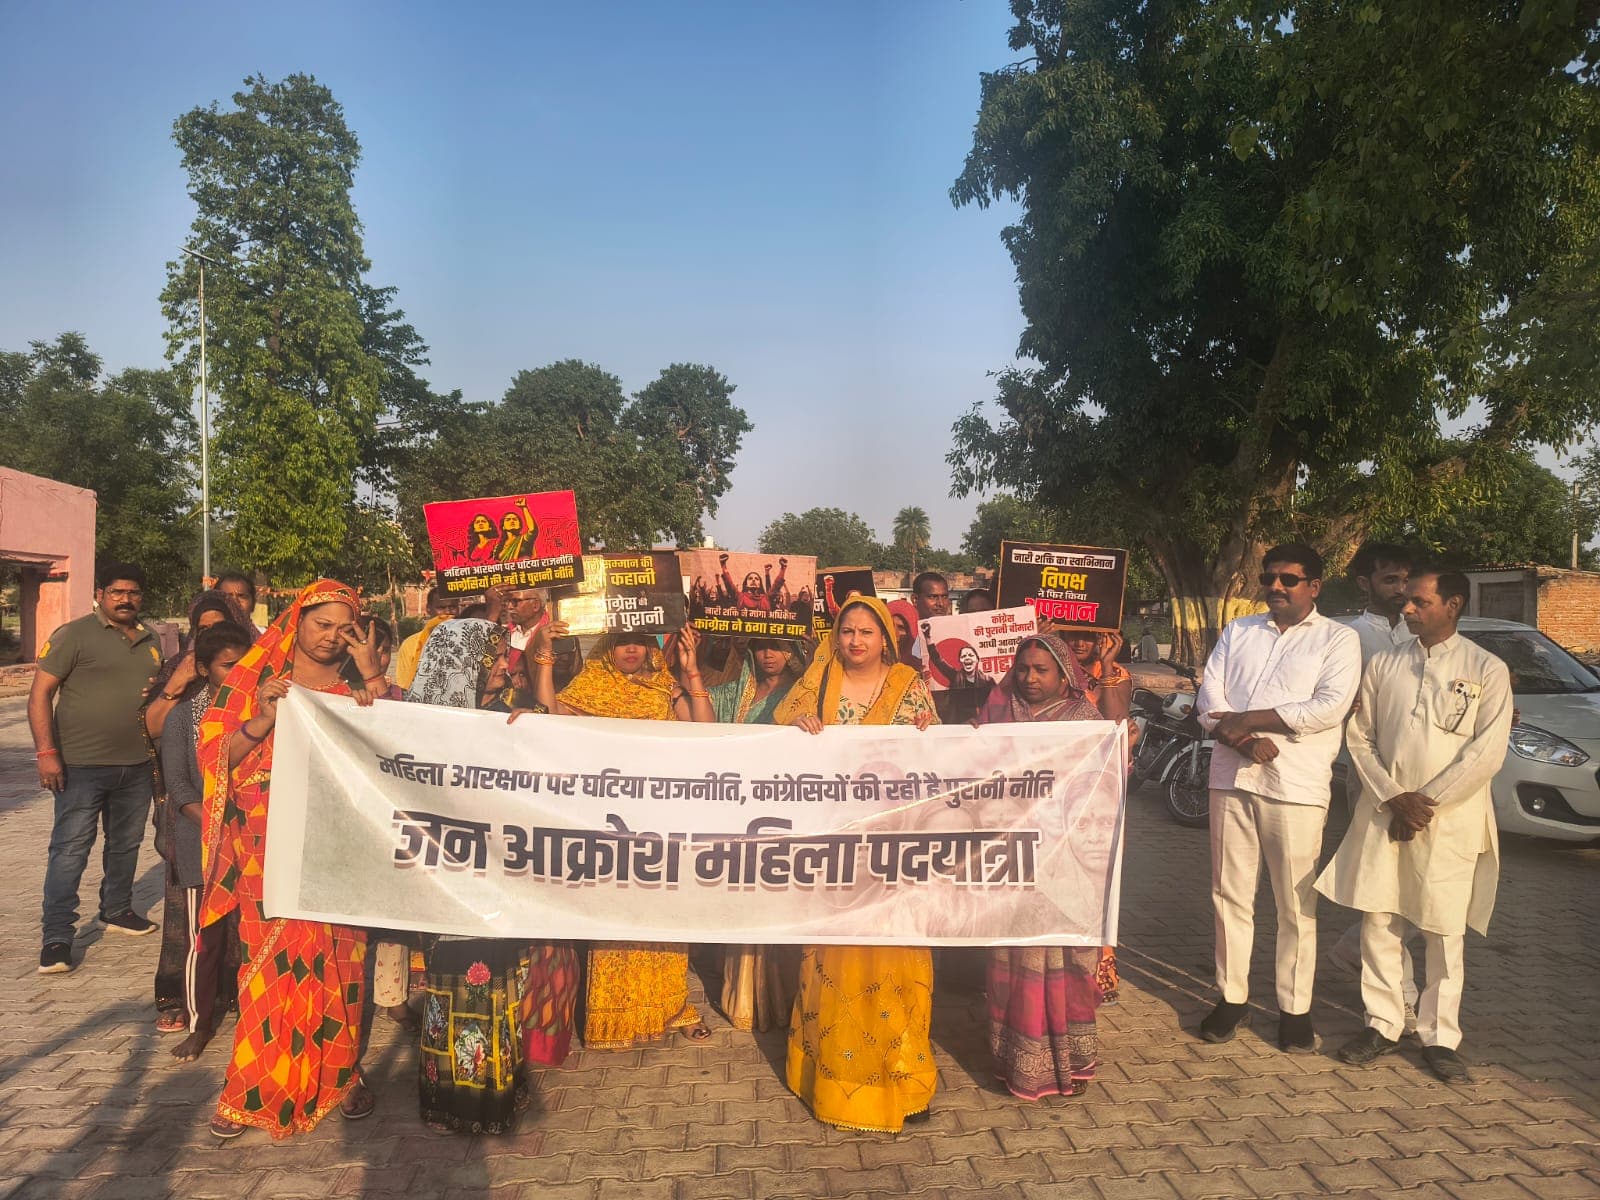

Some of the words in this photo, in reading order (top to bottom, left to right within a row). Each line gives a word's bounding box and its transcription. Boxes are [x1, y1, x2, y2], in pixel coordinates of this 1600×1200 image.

[444, 566, 471, 577] महिला
[473, 563, 503, 574] आरक्षण
[504, 562, 516, 571] पर
[517, 559, 540, 570] घटिया
[541, 554, 574, 567] राजनीति
[640, 555, 654, 569] की
[1014, 552, 1033, 562] नारी
[1035, 553, 1055, 564] शक्ति
[1056, 555, 1068, 565] का
[1069, 556, 1114, 569] स्वाभिमान
[447, 574, 489, 592] कांग्रेसियों
[503, 571, 519, 585] रही
[519, 570, 527, 584] है
[527, 568, 553, 587] पुरानी
[554, 565, 574, 579] नीति
[610, 568, 657, 586] कहानी
[1041, 566, 1088, 591] विपक्ष
[1038, 588, 1045, 598] ने
[1046, 589, 1064, 600] फिर
[1064, 590, 1088, 601] किया
[620, 606, 665, 632] पुरानी
[704, 606, 721, 616] नारी
[722, 607, 739, 617] शक्ति
[991, 613, 1015, 624] कांग्रेस
[694, 616, 730, 632] कांग्रेस
[731, 618, 743, 633] ने
[745, 622, 767, 634] ठगा
[769, 623, 785, 635] हर
[985, 624, 1008, 638] पुरानी
[376, 753, 447, 787] महिला
[450, 764, 544, 793] आरक्षण
[544, 772, 579, 796] पर
[580, 768, 647, 799] घटिया
[649, 771, 747, 805] राजनीति,
[751, 773, 851, 802] कांग्रेसियों
[851, 772, 882, 801] की
[882, 772, 923, 801] रही
[923, 772, 944, 800] है
[944, 770, 1007, 808] पुरानी
[1007, 769, 1056, 799] नीति
[393, 810, 492, 870] जन
[503, 813, 688, 884] आक्रोश
[690, 817, 864, 885] महिला
[866, 831, 1040, 885] पदयात्रा
